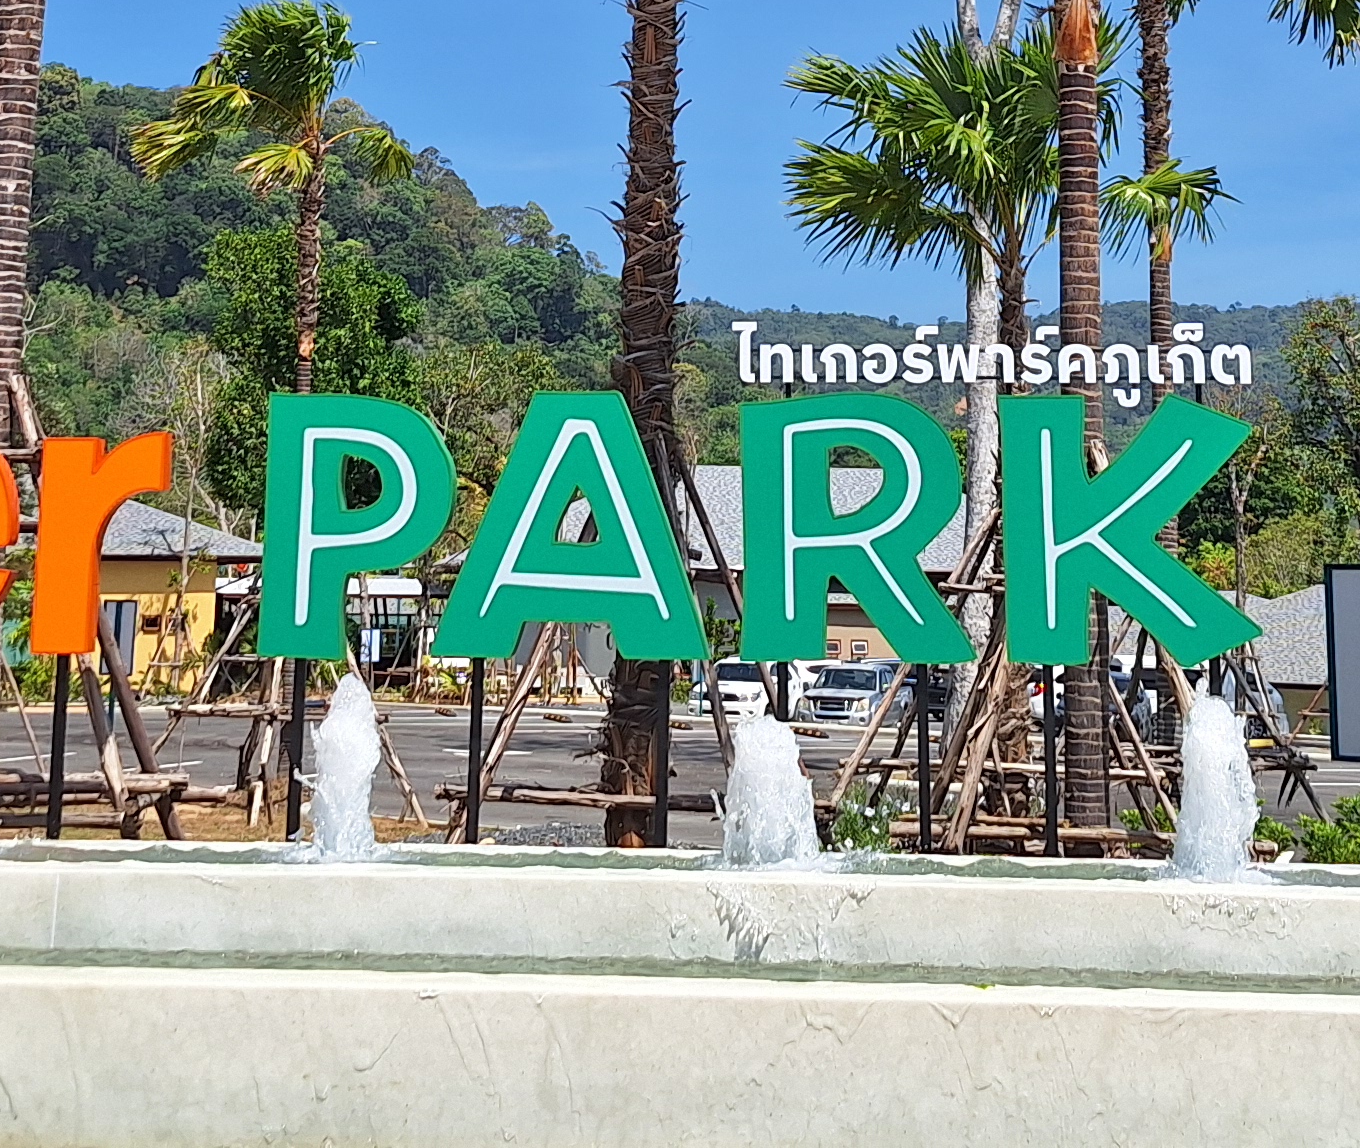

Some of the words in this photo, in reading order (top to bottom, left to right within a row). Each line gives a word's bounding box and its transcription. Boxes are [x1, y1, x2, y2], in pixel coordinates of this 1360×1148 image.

[731, 321, 1253, 408] ไทเกอร์พาร์คภูเก็ต
[256, 391, 1263, 668] PARK
